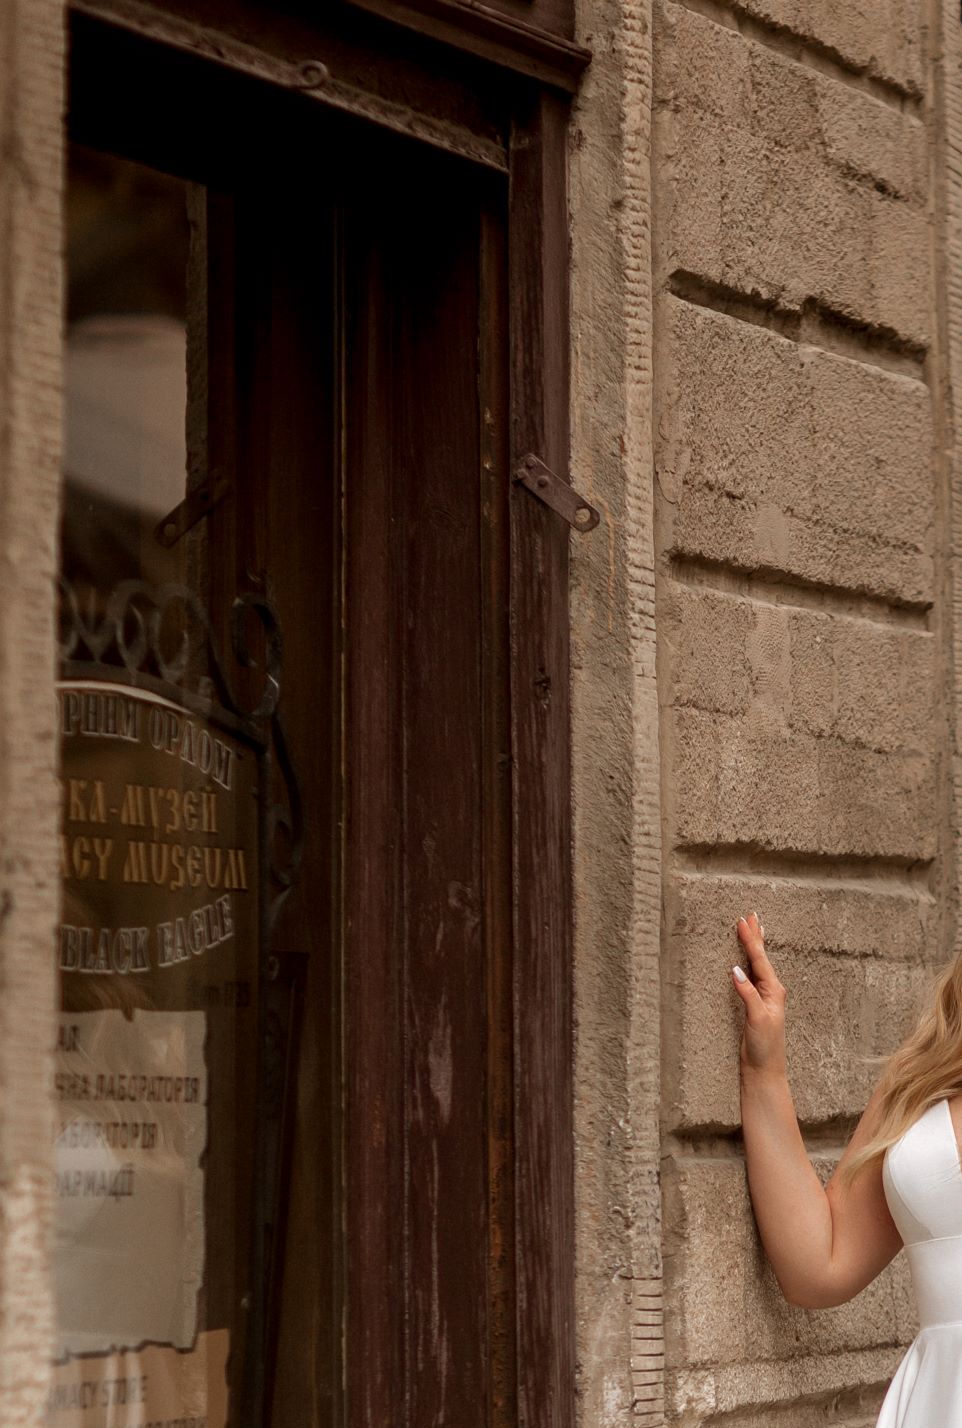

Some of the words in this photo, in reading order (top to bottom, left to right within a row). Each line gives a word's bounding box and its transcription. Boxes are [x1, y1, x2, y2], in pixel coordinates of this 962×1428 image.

[149, 705, 233, 791] ОРЛОМ
[68, 778, 219, 838] КА-МУЗЕЙ
[123, 840, 248, 890] MUSEUM
[59, 922, 151, 975] BLACK
[157, 893, 234, 968] EAGLE
